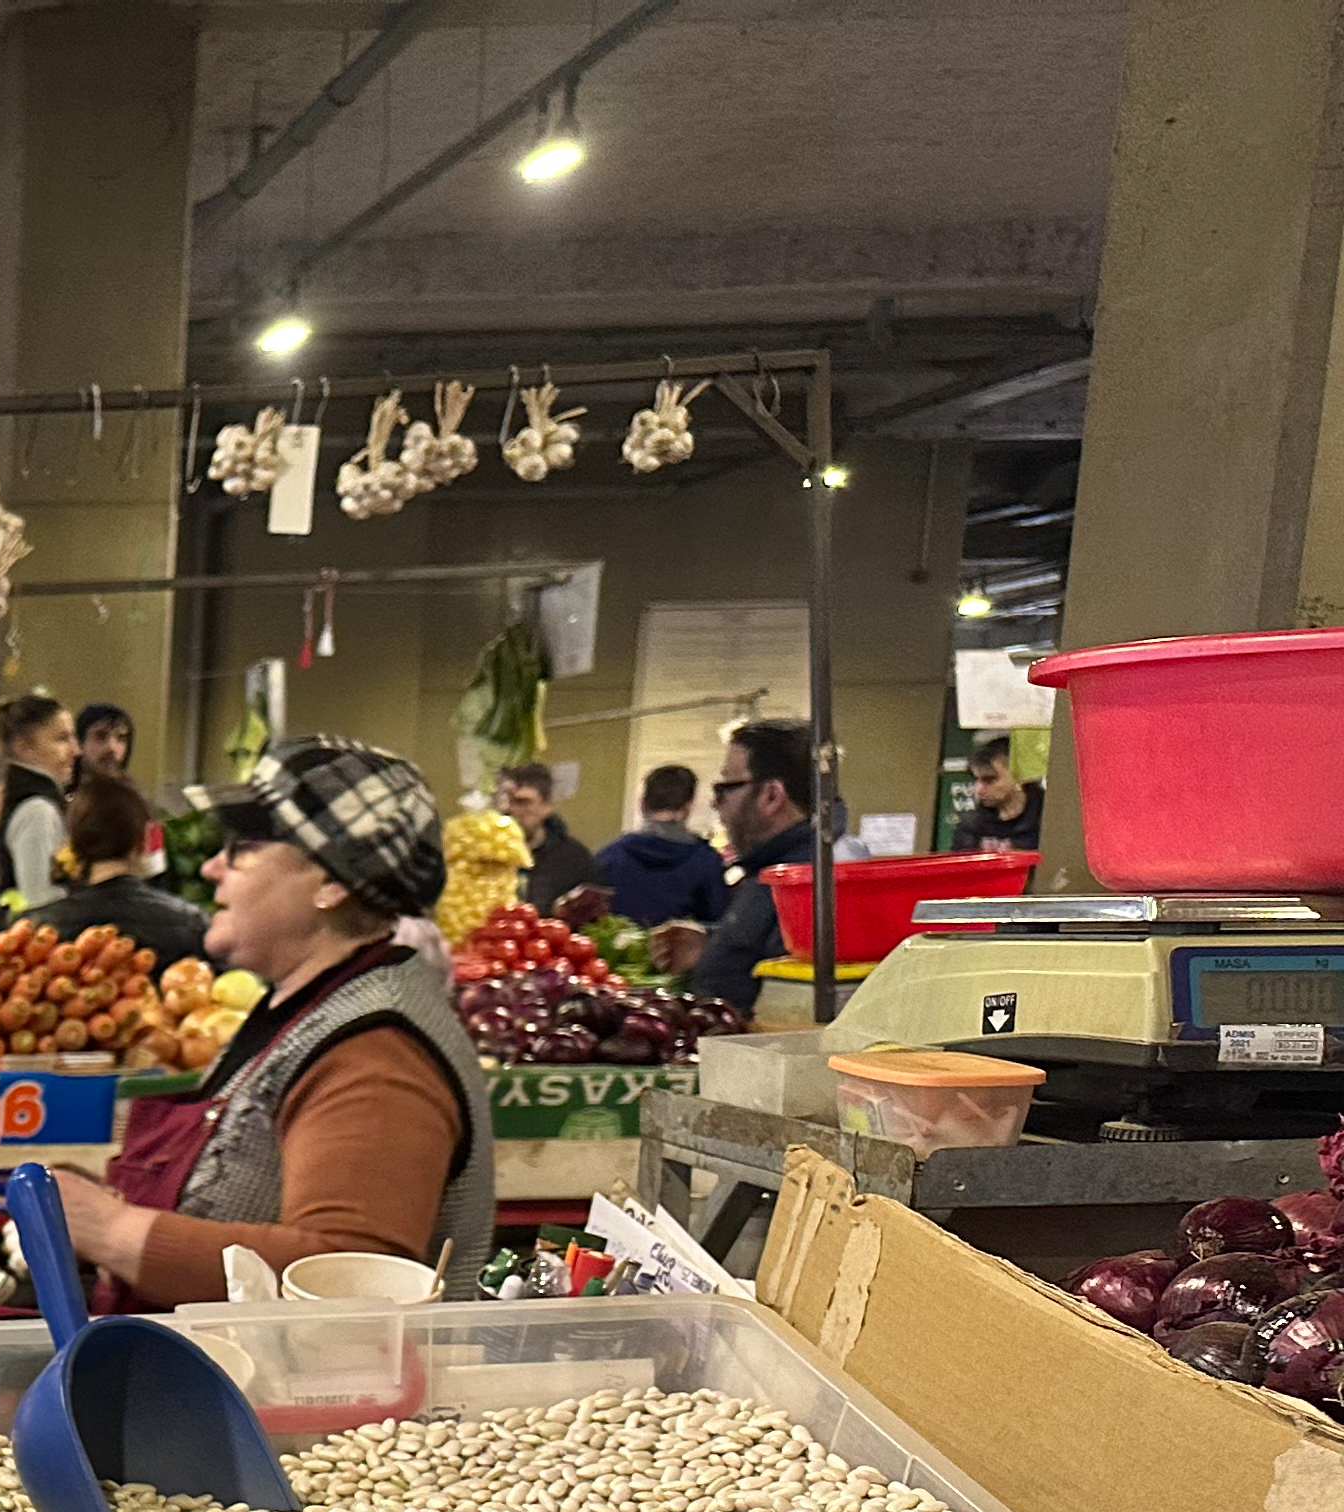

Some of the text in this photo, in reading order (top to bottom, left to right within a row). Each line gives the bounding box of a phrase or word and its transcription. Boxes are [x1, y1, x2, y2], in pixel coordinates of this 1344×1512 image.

[1214, 958, 1251, 968] MASA
[985, 995, 1015, 1008] ON/OFF
[486, 1073, 697, 1107] EKASY
